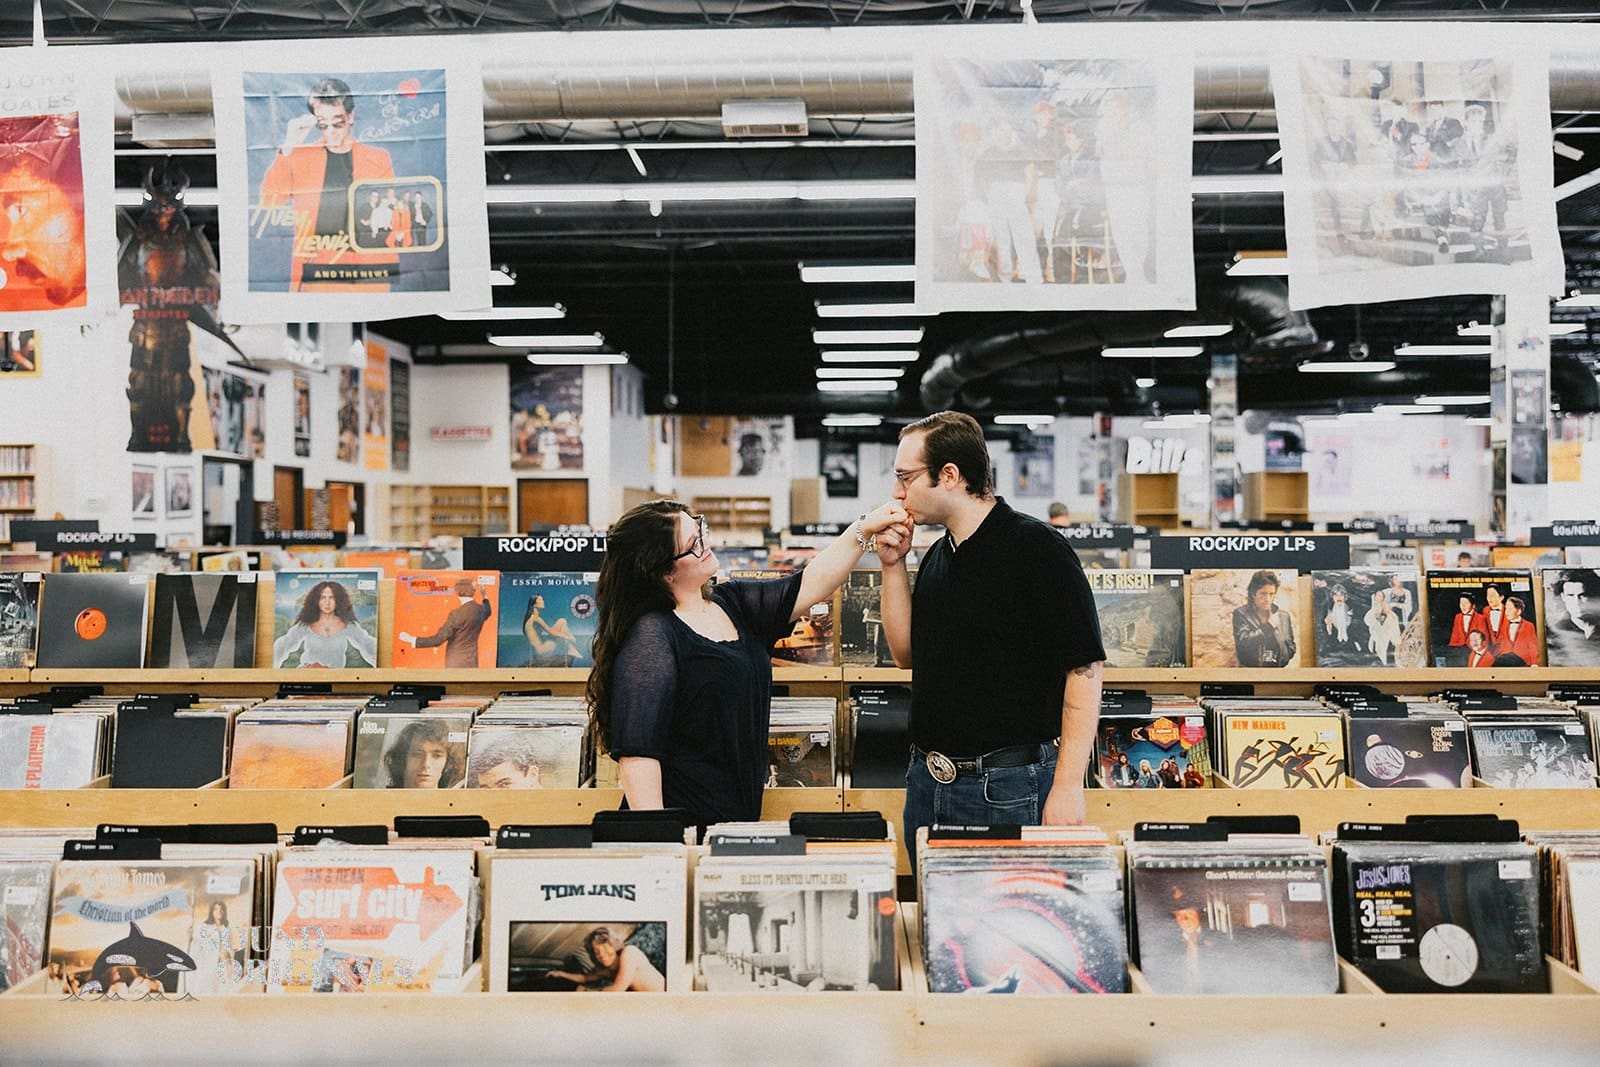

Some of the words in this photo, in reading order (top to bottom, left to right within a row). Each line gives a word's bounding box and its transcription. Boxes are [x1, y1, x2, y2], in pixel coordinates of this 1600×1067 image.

[314, 270, 337, 278] AND
[340, 270, 358, 278] THE
[360, 269, 389, 278] NEWS
[57, 532, 113, 543] ROCK/POP
[115, 532, 135, 543] LPs
[1093, 528, 1113, 538] LPs
[498, 538, 585, 552] ROCK/POP
[1190, 537, 1280, 551] ROCK/POP
[1284, 537, 1316, 551] LPs
[547, 578, 590, 586] MOHAWK
[1102, 574, 1114, 589] IS
[1116, 574, 1154, 589] RISEN!
[1232, 720, 1249, 730] NEW
[1252, 720, 1286, 730] MARINES
[27, 725, 46, 781] PLATINUM
[1356, 867, 1385, 889] JESUS
[1384, 865, 1411, 885] JONES
[540, 884, 585, 901] TOM
[587, 884, 636, 902] JANS
[296, 883, 363, 920] surf
[366, 883, 424, 921] city
[1359, 899, 1376, 928] 3
